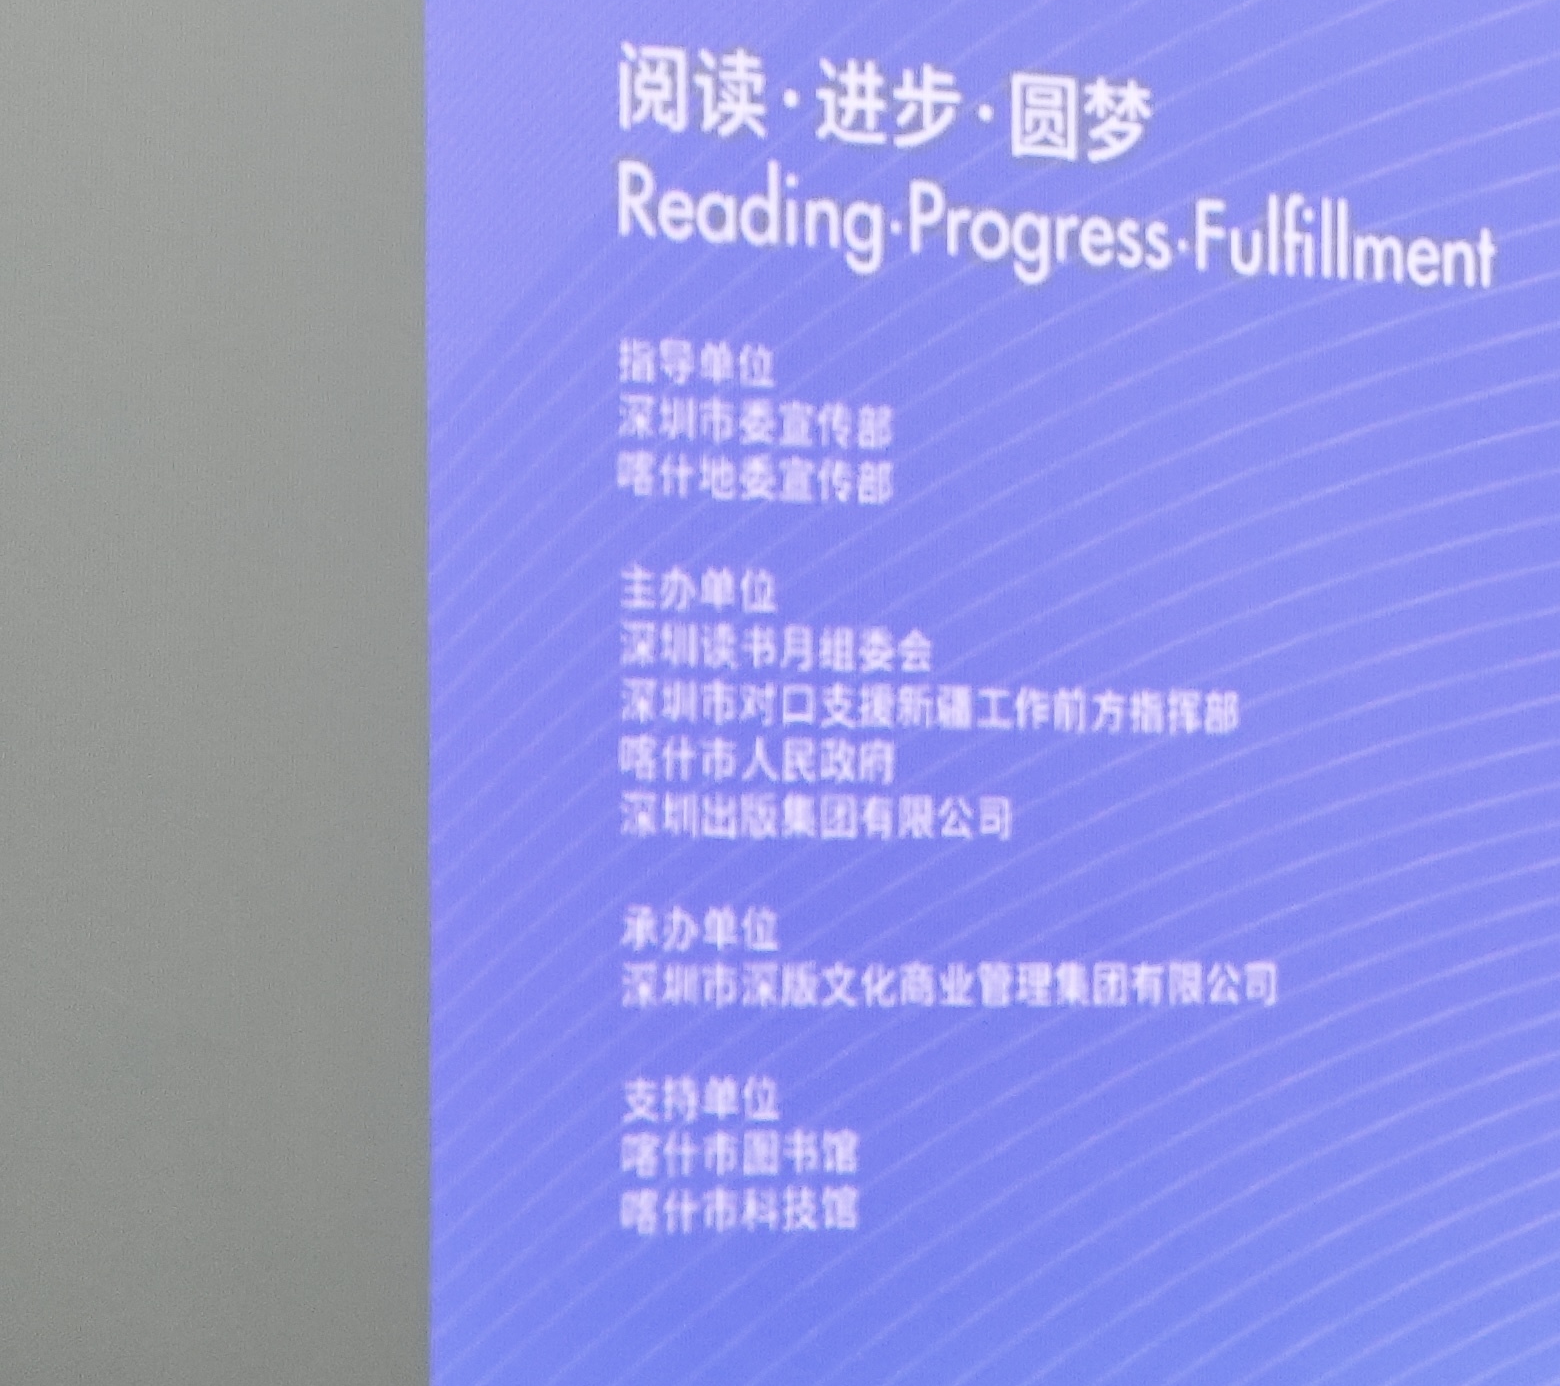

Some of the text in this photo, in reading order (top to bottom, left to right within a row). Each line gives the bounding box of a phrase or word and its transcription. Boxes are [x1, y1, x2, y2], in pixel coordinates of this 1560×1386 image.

[619, 337, 775, 387] 指导单位
[618, 393, 894, 450] 深圳市委宣传部
[616, 449, 894, 505] 喀什地委宣传部
[620, 562, 778, 613] 主办单位
[620, 619, 932, 673] 深圳读书月组委会
[621, 676, 1240, 735] 深圳市对口支援新疆工作前方指挥部
[617, 732, 895, 785] 喀什市人民政府
[620, 790, 1012, 841] 深圳出版集团有限公司
[620, 904, 779, 952] 承办单位
[622, 1074, 780, 1124] 支持单位
[620, 1128, 858, 1179] 喀什市图书馆
[620, 1184, 858, 1235] 喀什市科技馆
